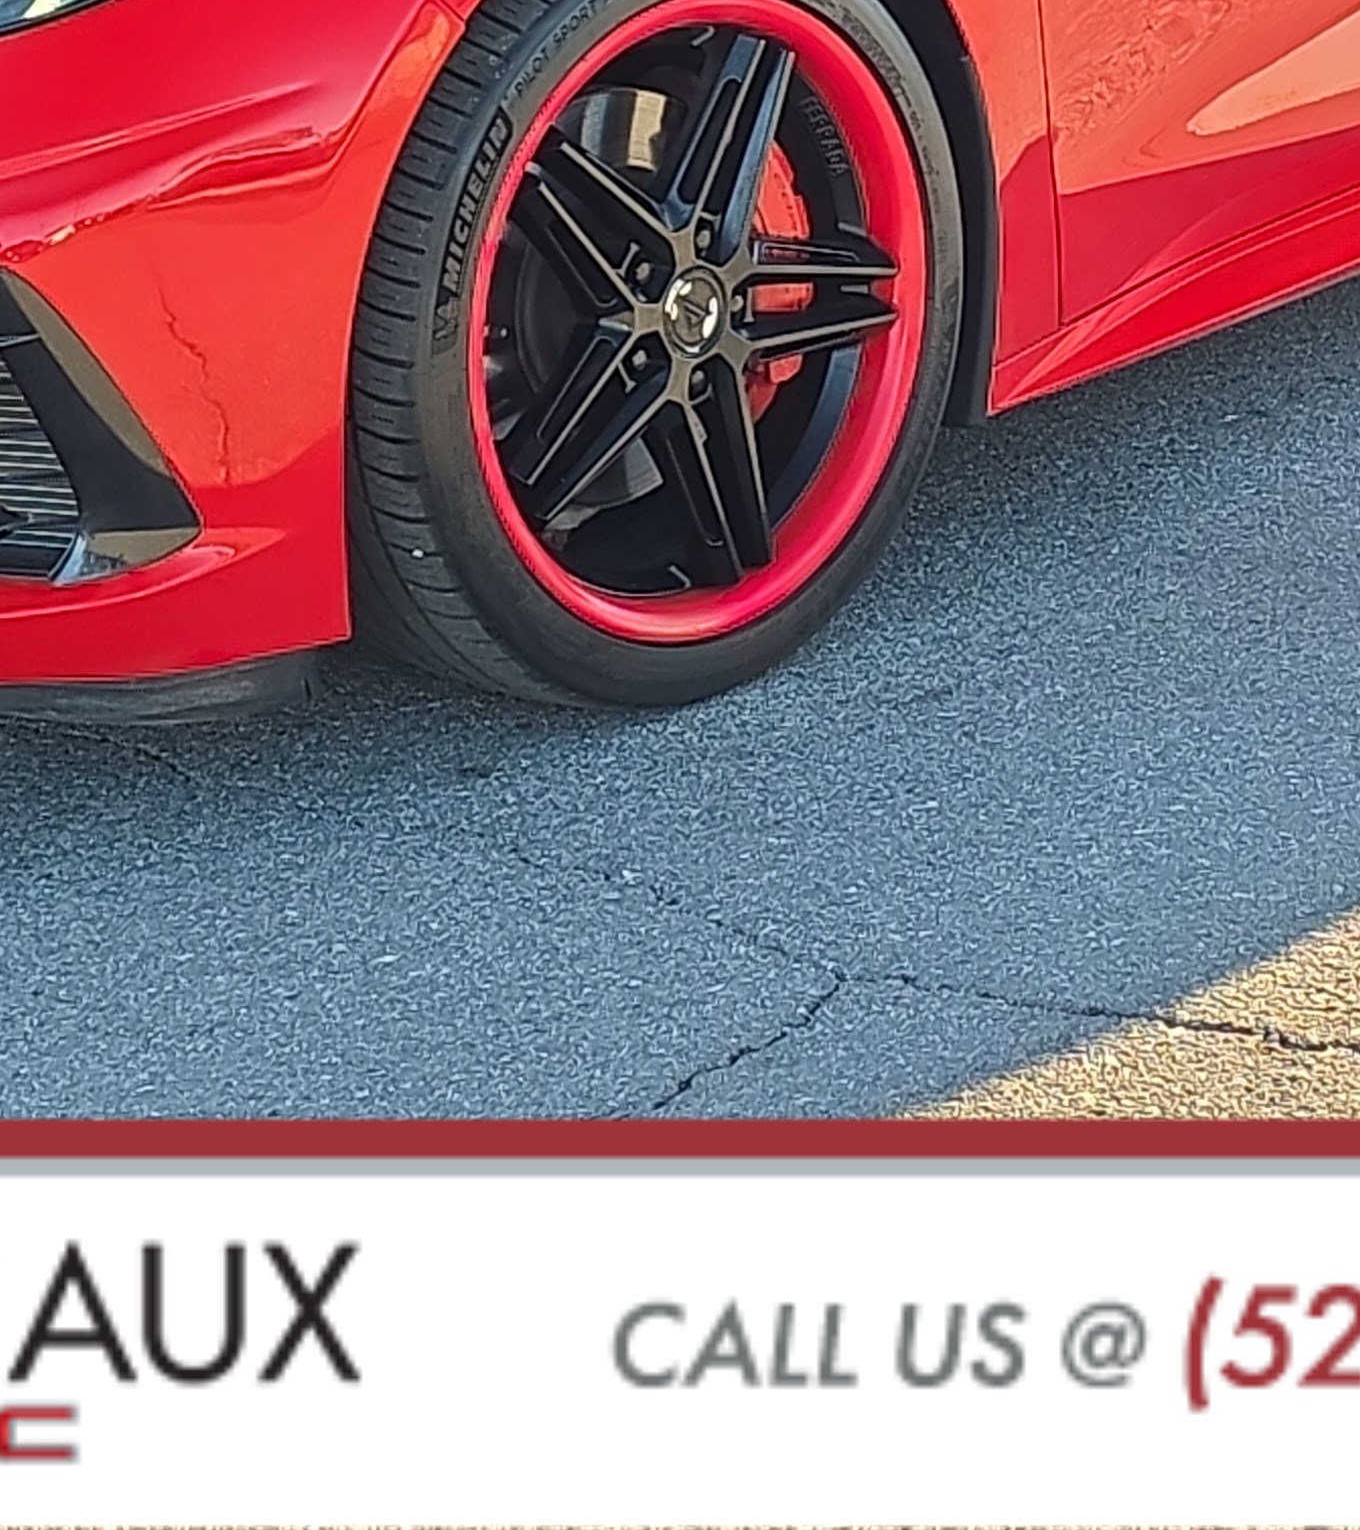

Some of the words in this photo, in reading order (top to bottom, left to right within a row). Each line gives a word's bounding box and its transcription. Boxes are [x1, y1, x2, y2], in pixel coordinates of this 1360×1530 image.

[441, 118, 509, 293] MICHELIN
[513, 49, 551, 97] PILOT
[552, 0, 603, 47] SPORT
